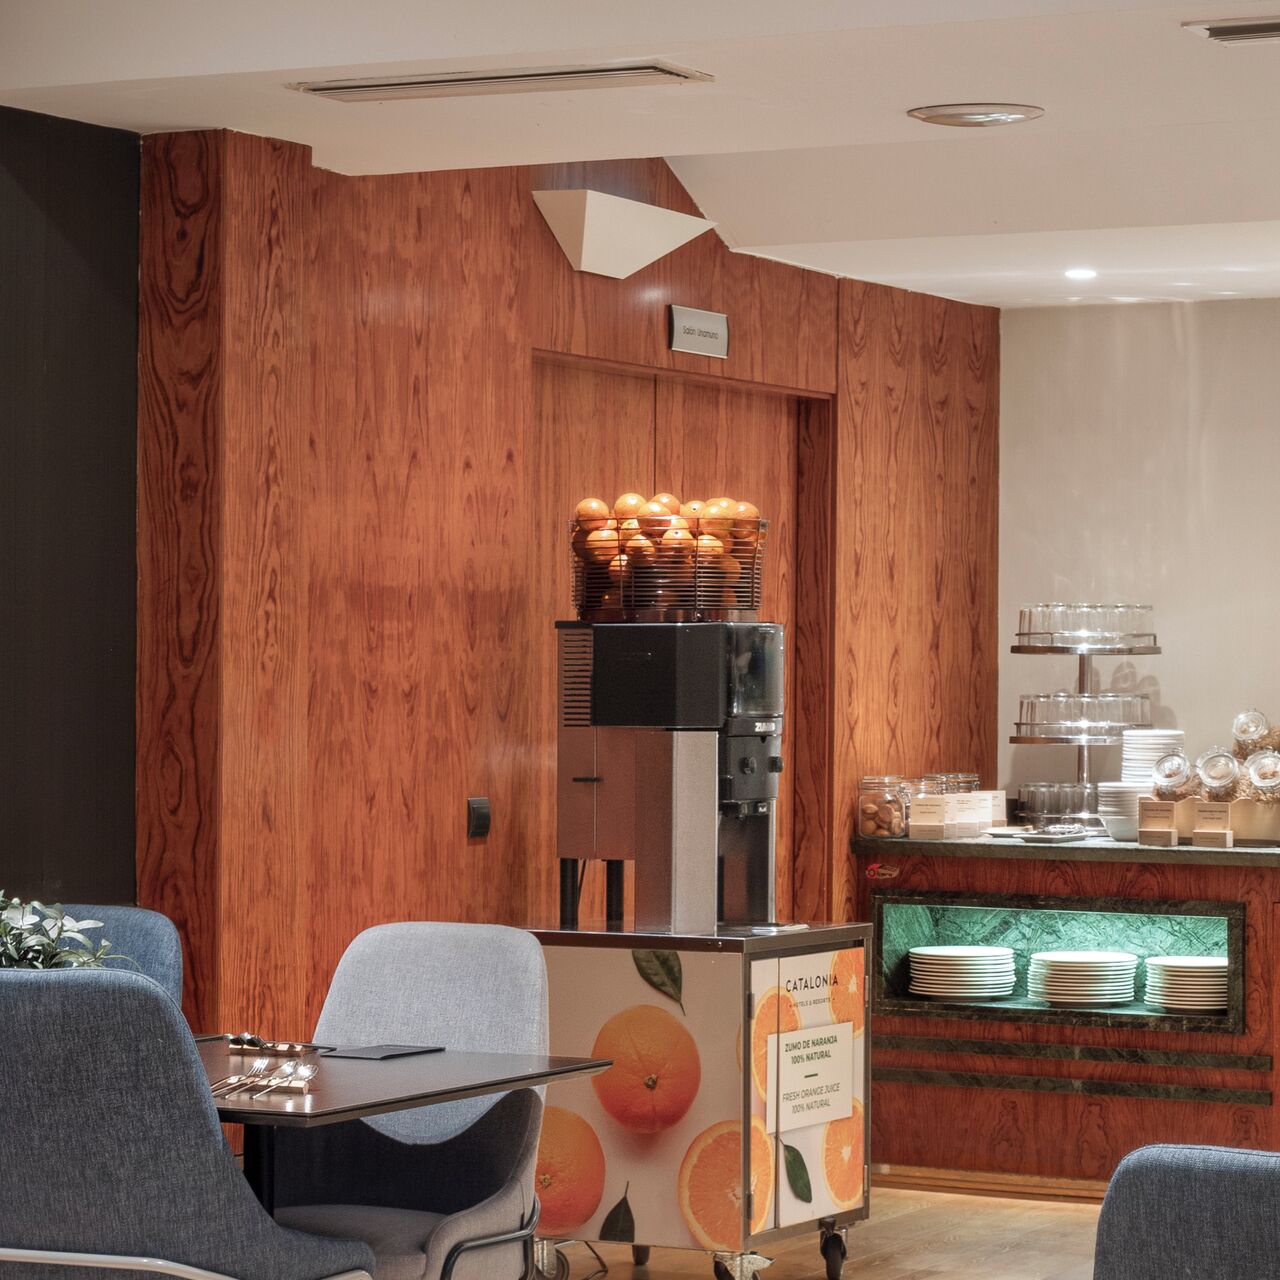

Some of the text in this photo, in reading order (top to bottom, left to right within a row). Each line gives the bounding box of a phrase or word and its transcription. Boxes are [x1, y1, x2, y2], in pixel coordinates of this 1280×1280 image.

[785, 974, 839, 993] CATALONIA
[785, 1035, 837, 1052] ZUMO DE NARANJA
[791, 1050, 831, 1064] 100% NATURAL
[782, 1082, 840, 1102] FRESH ORANGE JUICE
[791, 1098, 831, 1114] 100% NATURAL
